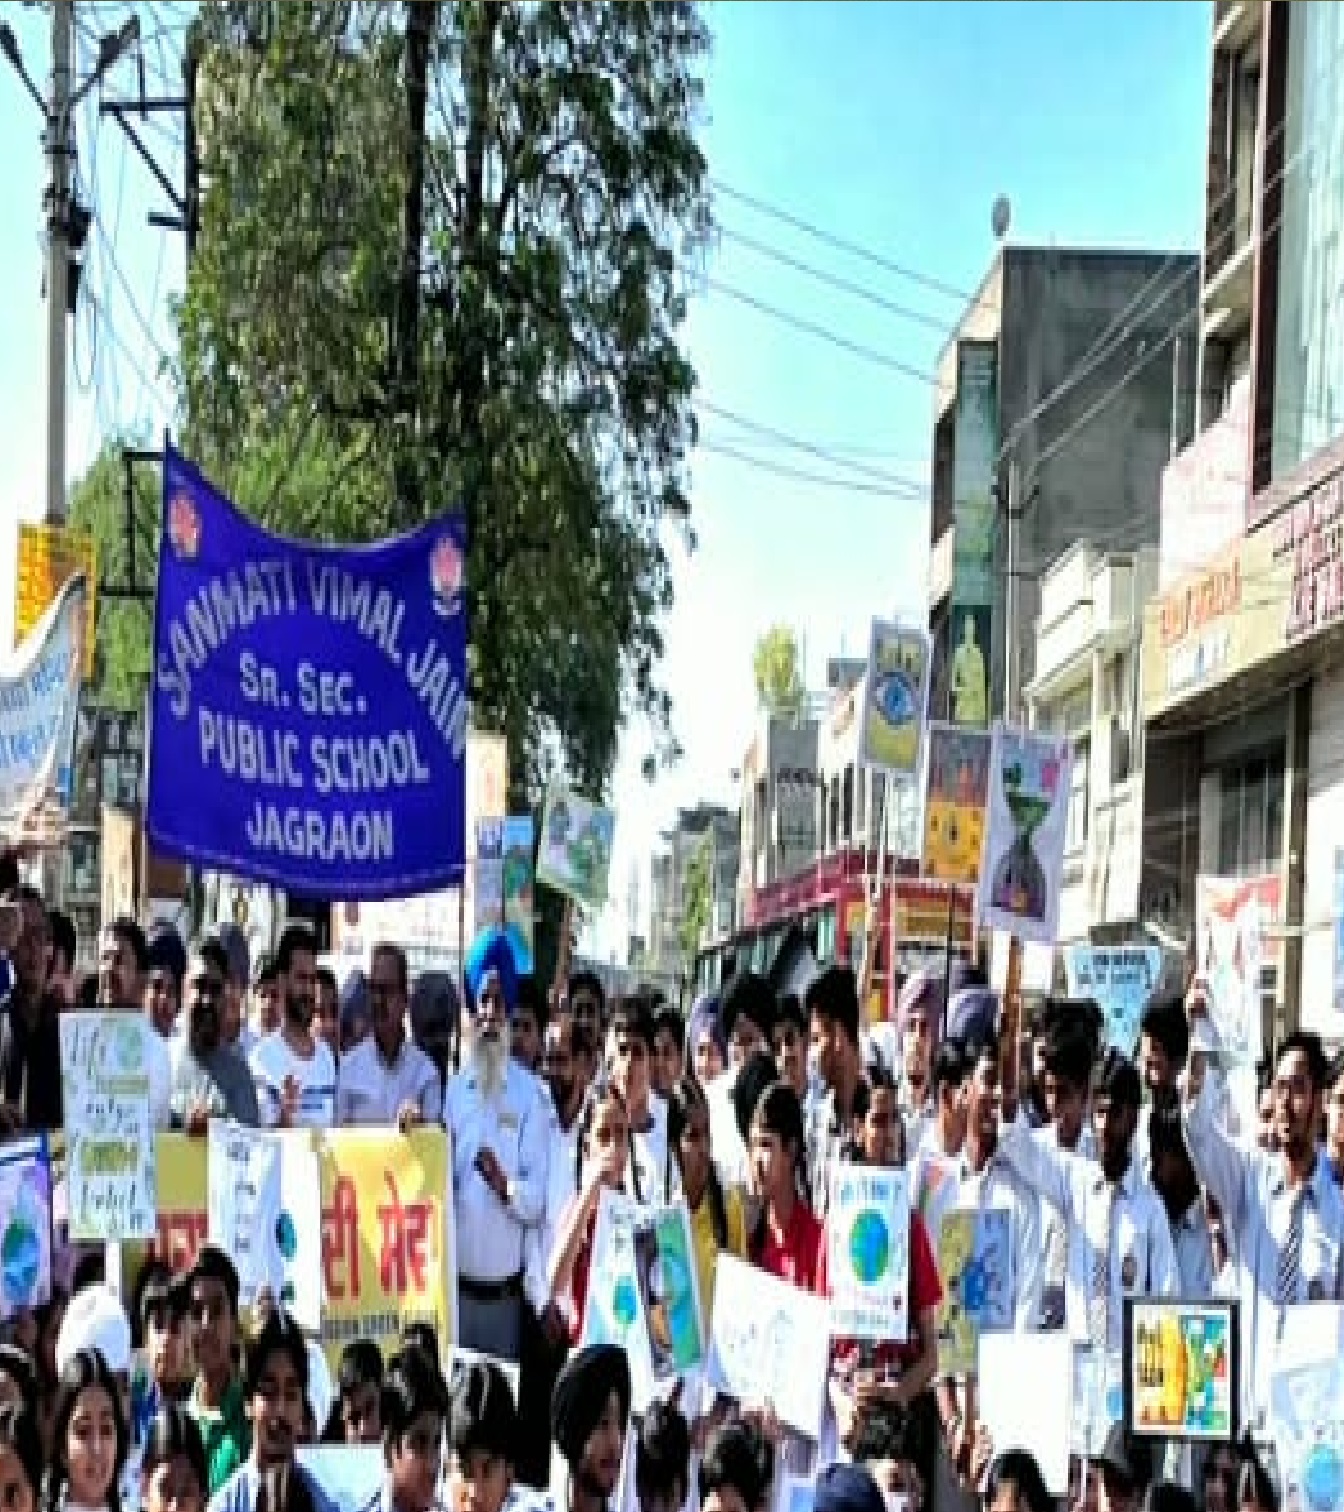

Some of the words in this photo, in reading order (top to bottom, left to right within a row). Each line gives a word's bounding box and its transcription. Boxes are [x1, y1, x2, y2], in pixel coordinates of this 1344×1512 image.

[157, 561, 297, 721] SANMATI
[309, 560, 407, 664] VIMAL
[406, 639, 468, 763] JAIN
[198, 710, 303, 788] PUBLIC
[310, 735, 430, 794] SCHOOL
[246, 801, 394, 861] JAGRAON
